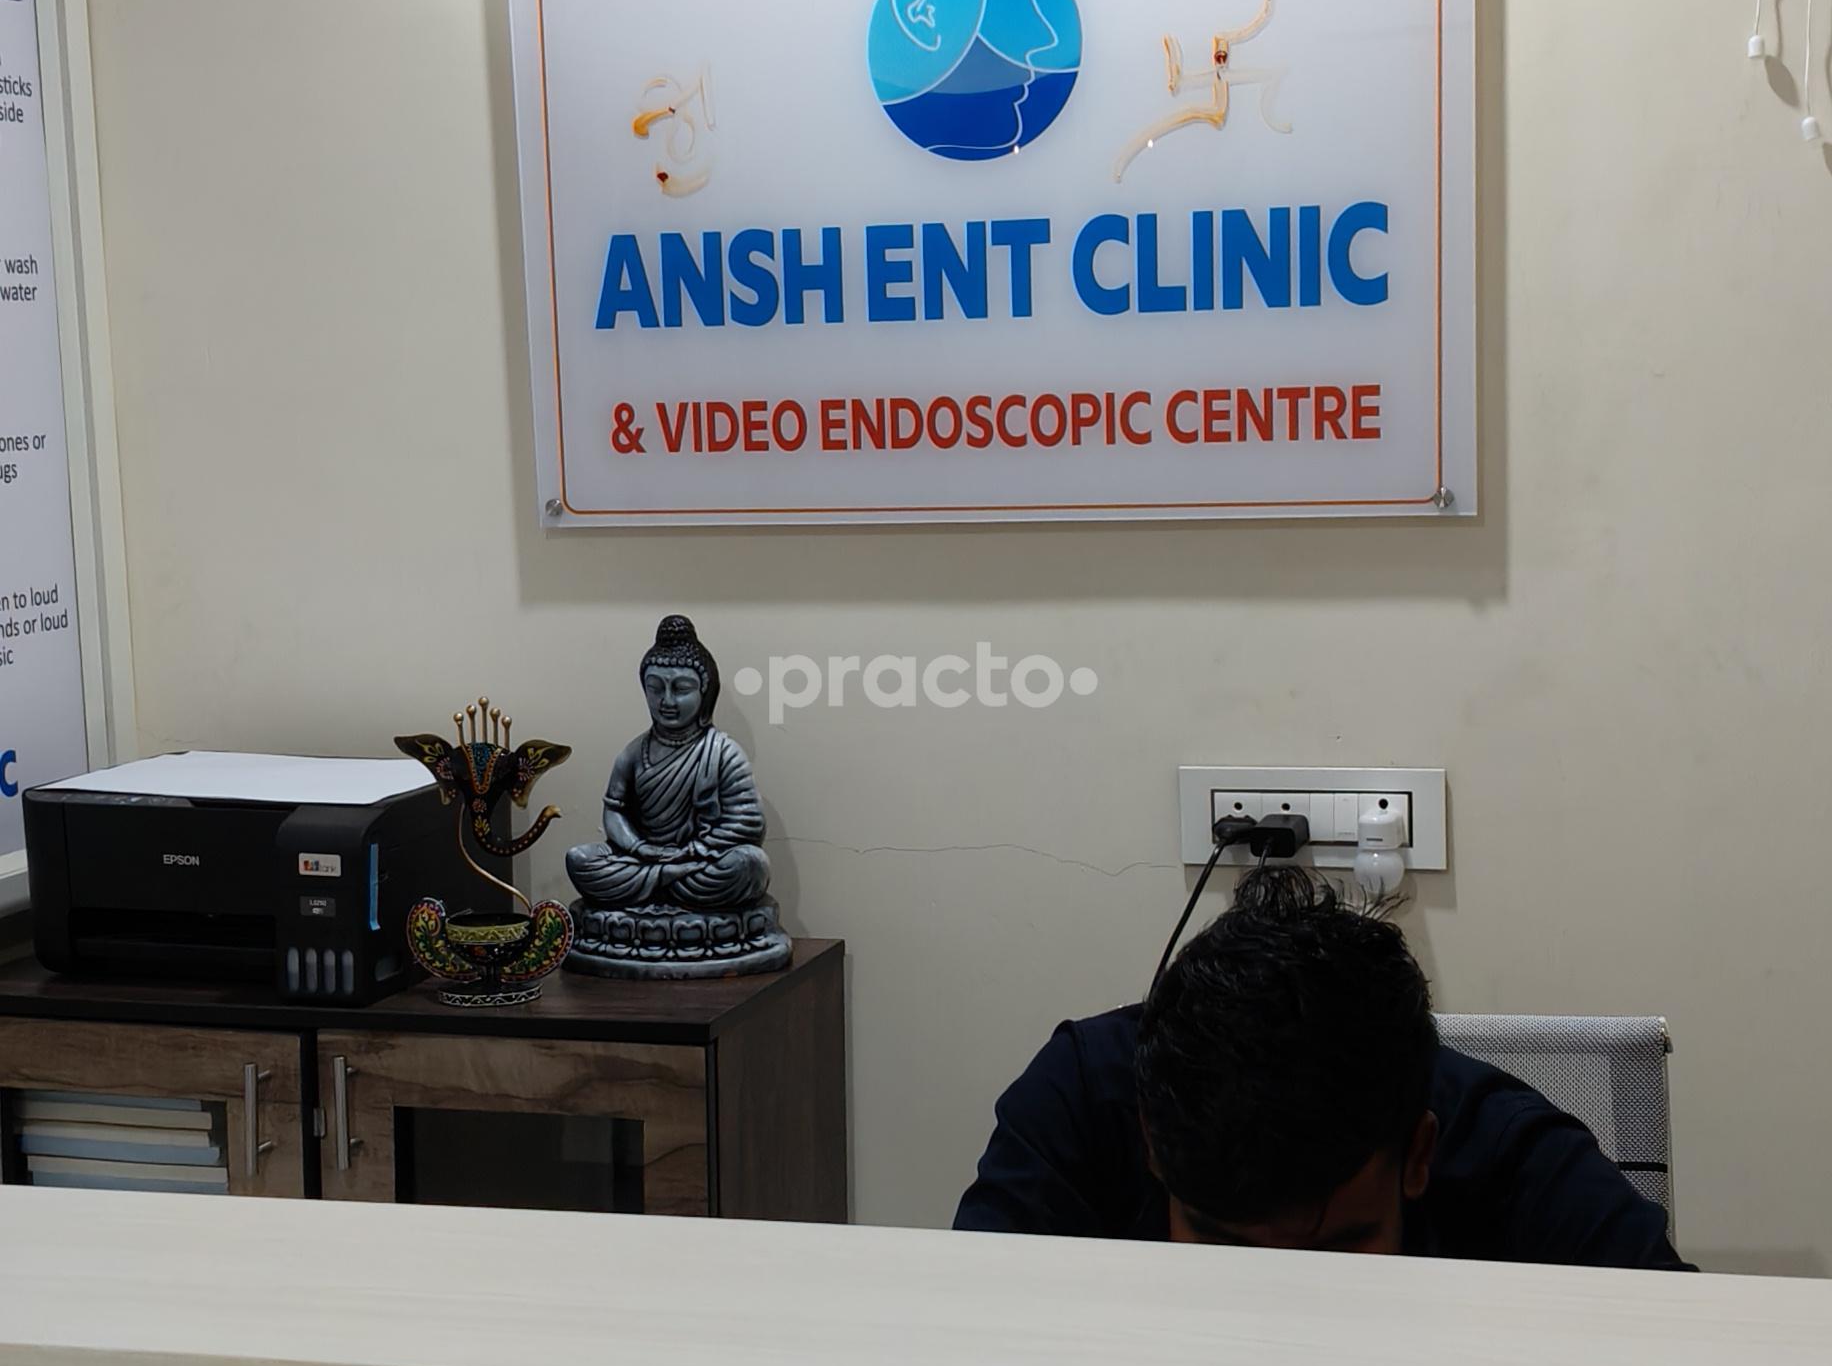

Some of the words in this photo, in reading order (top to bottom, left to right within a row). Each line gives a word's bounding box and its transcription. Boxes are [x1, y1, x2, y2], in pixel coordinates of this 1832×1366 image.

[4, 254, 38, 275] wash
[595, 226, 845, 330] ANSH
[865, 217, 1051, 323] ENT
[1072, 201, 1389, 316] CLINIC
[0, 283, 37, 302] water
[610, 402, 647, 454] &
[655, 399, 808, 453] VIDEO
[820, 391, 1152, 451] ENDOSCOPIC
[1166, 384, 1382, 444] CENTRE
[32, 434, 46, 450] or
[13, 592, 27, 609] to
[30, 583, 58, 607] loud
[23, 619, 37, 635] or
[40, 608, 68, 632] loud
[163, 854, 200, 866] EPSON
